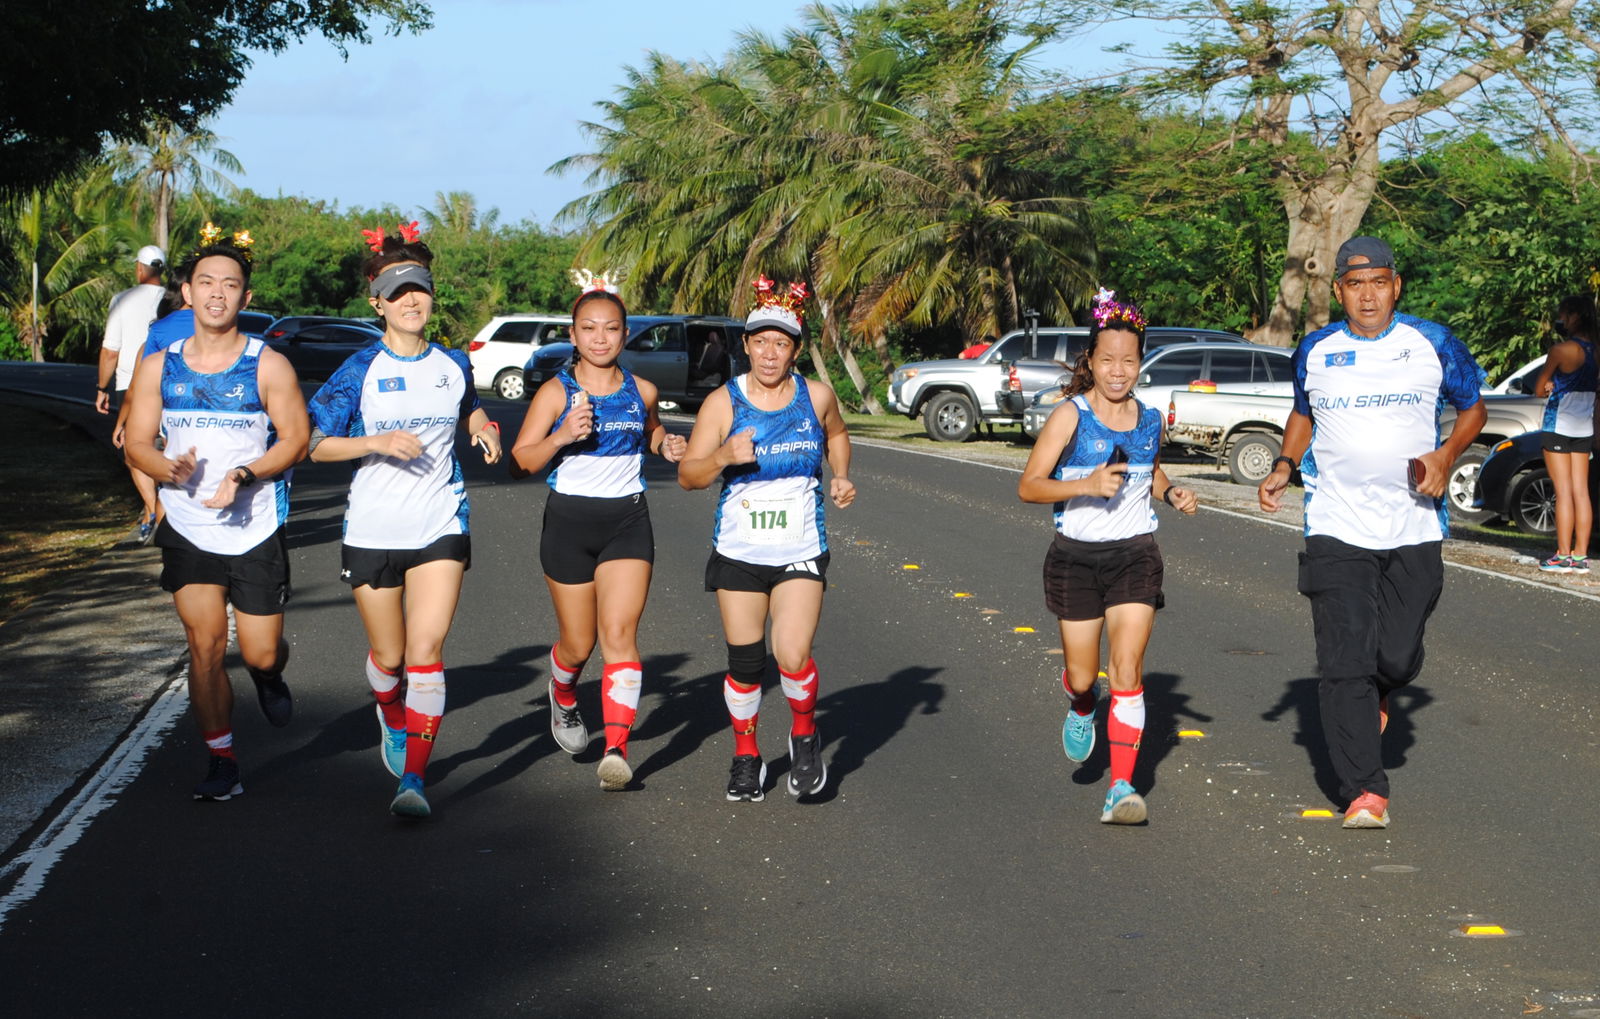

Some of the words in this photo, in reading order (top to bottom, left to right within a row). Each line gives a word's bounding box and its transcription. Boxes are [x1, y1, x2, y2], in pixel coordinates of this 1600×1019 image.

[1317, 396, 1350, 410] RUN
[1354, 392, 1423, 408] SAIPAN
[166, 416, 192, 429] RUN
[195, 417, 256, 430] SAIPAN
[408, 416, 457, 429] SAIPA
[604, 421, 645, 432] SAIPAN
[770, 440, 818, 455] SAIPAN
[749, 510, 788, 529] 1174
